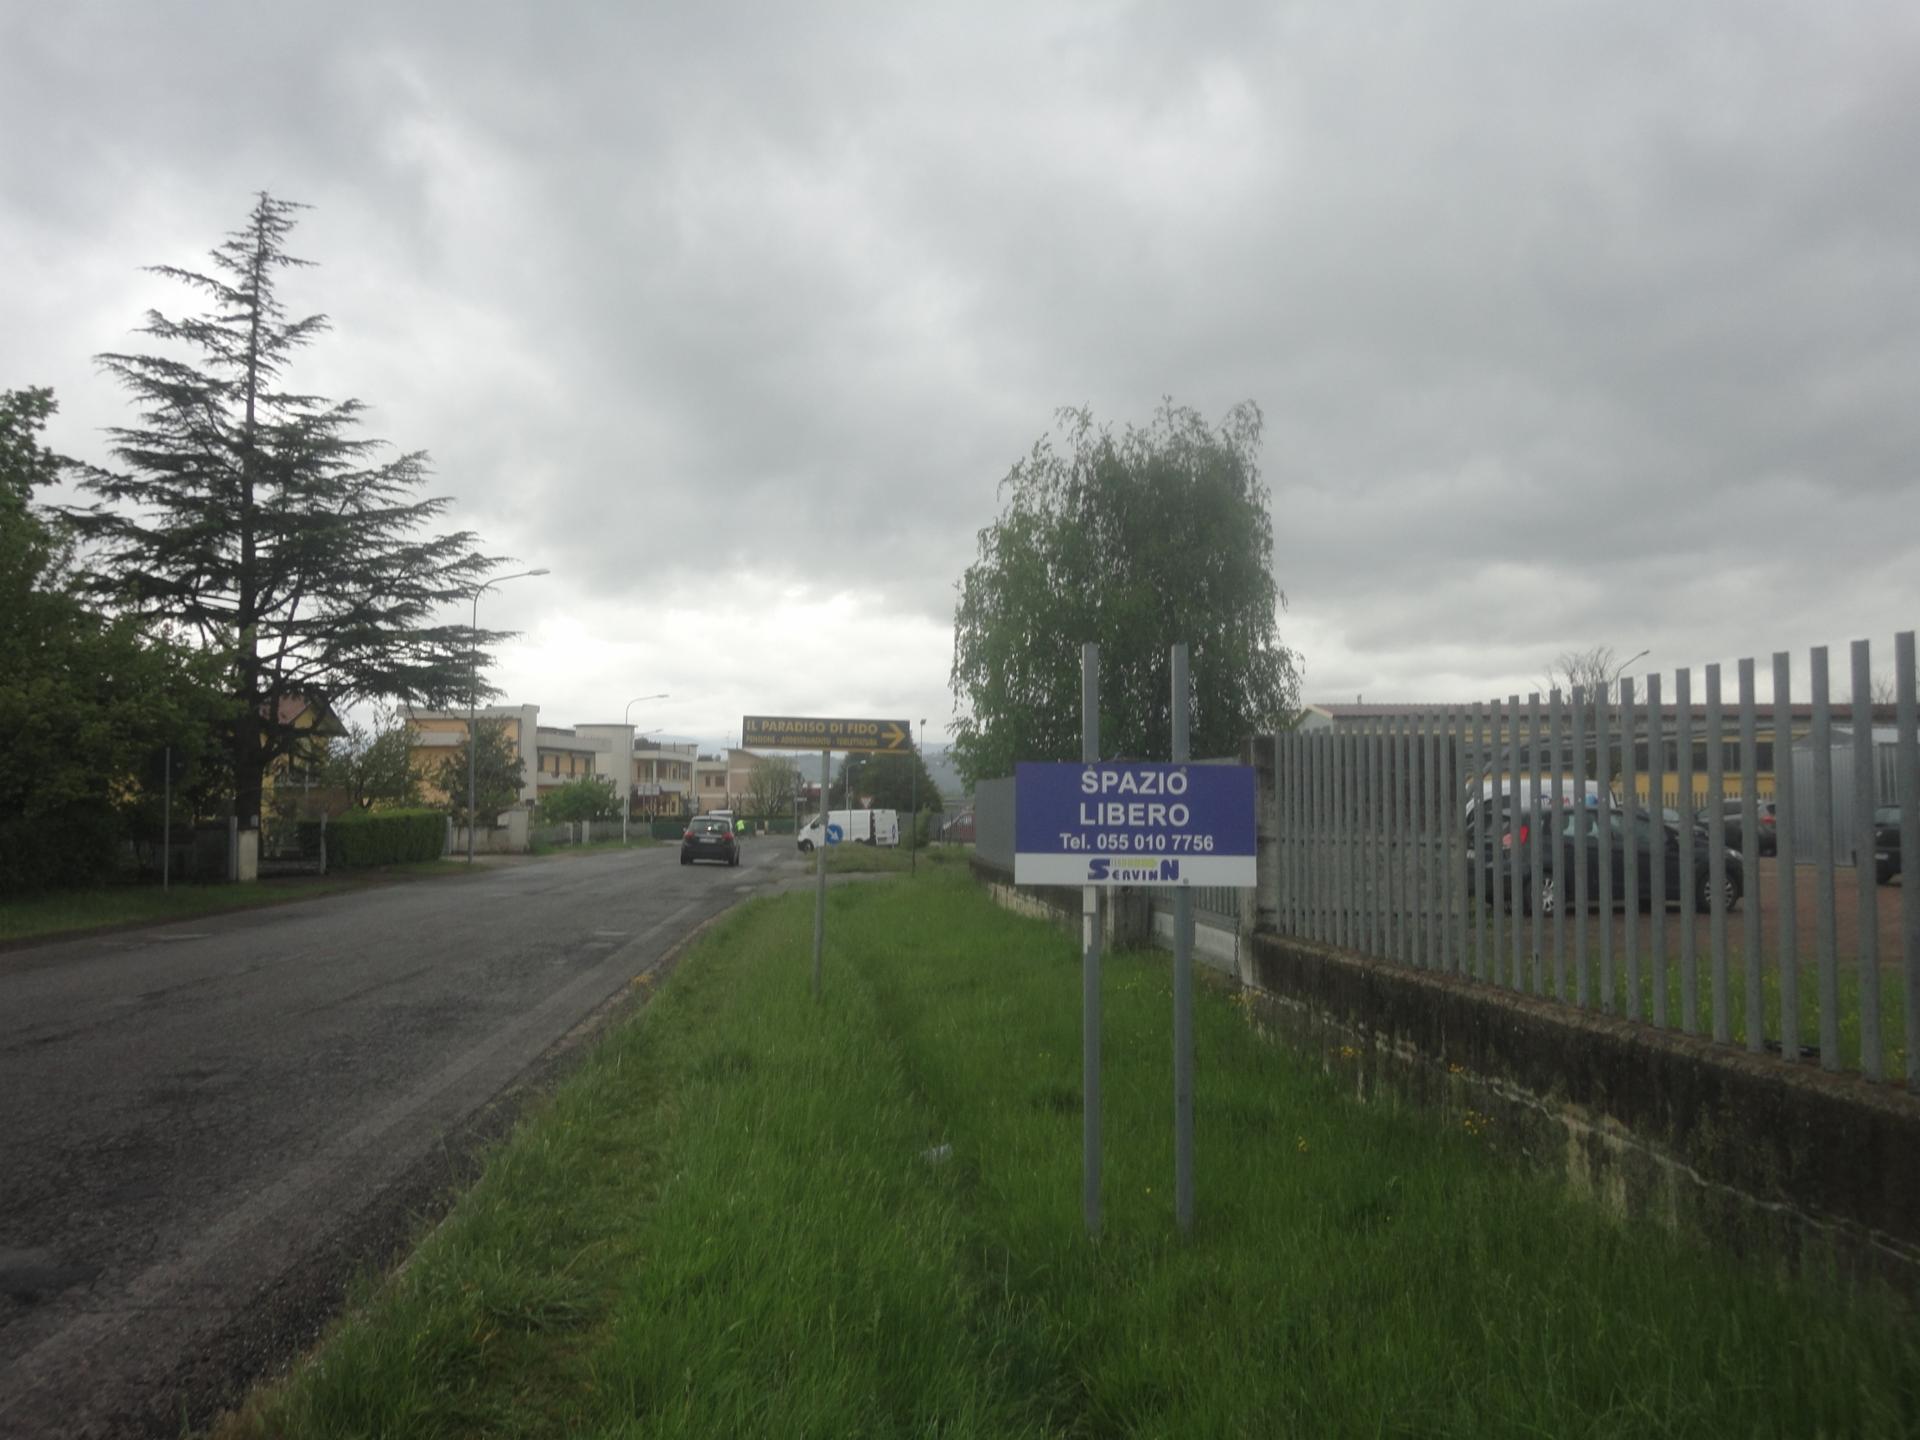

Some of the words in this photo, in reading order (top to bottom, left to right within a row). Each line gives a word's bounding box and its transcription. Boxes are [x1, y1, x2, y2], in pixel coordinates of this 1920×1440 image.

[762, 720, 826, 734] PARADISO
[830, 722, 843, 734] DI
[847, 722, 879, 735] FIDO
[1081, 770, 1188, 795] SPAZIO
[1080, 802, 1189, 827] LIBERO
[1060, 832, 1091, 849] Tel.
[1097, 833, 1129, 850] 055
[1134, 834, 1166, 851] 010
[1172, 835, 1214, 852] 7756
